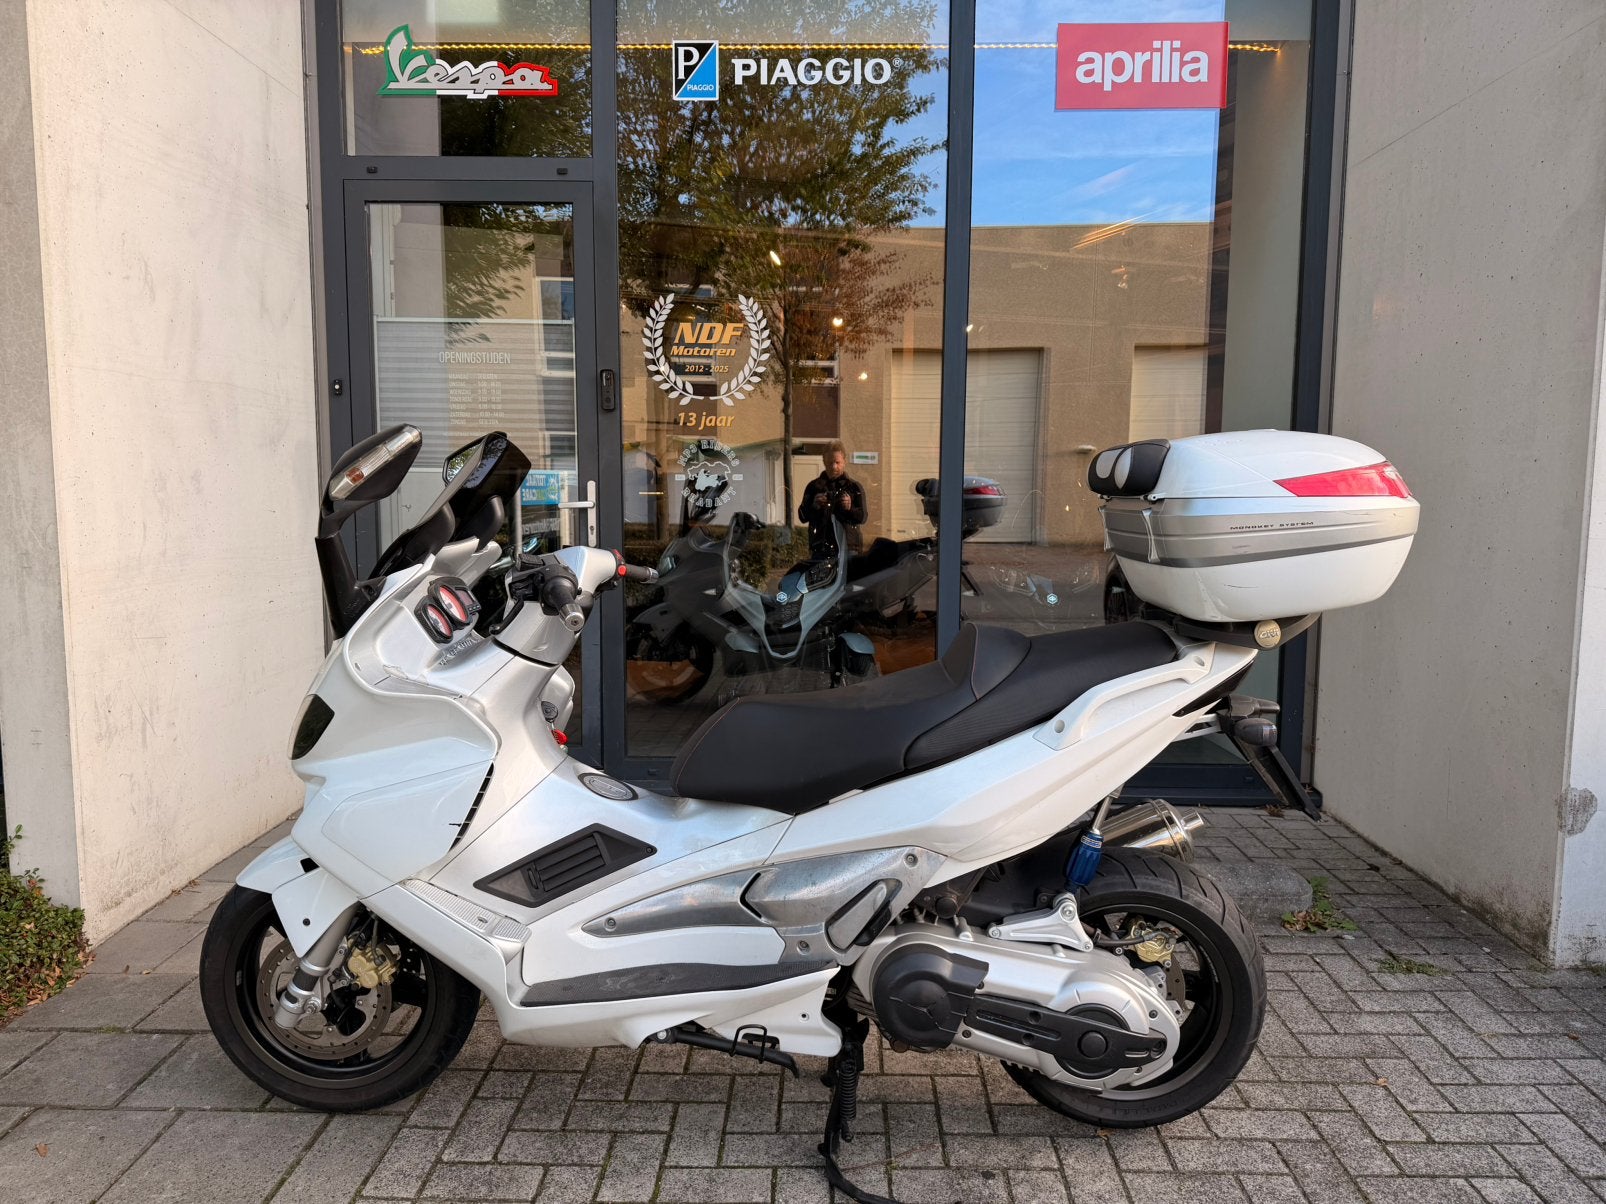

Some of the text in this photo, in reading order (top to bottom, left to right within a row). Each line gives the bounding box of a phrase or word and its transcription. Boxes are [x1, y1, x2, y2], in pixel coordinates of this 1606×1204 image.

[382, 27, 556, 97] Vespa
[676, 46, 699, 80] P
[1075, 40, 1209, 92] aprilia
[673, 322, 745, 344] NDF
[670, 345, 737, 357] Motoren
[685, 365, 704, 373] 2012
[710, 365, 729, 373] 2025
[678, 411, 735, 430] 13 jaar
